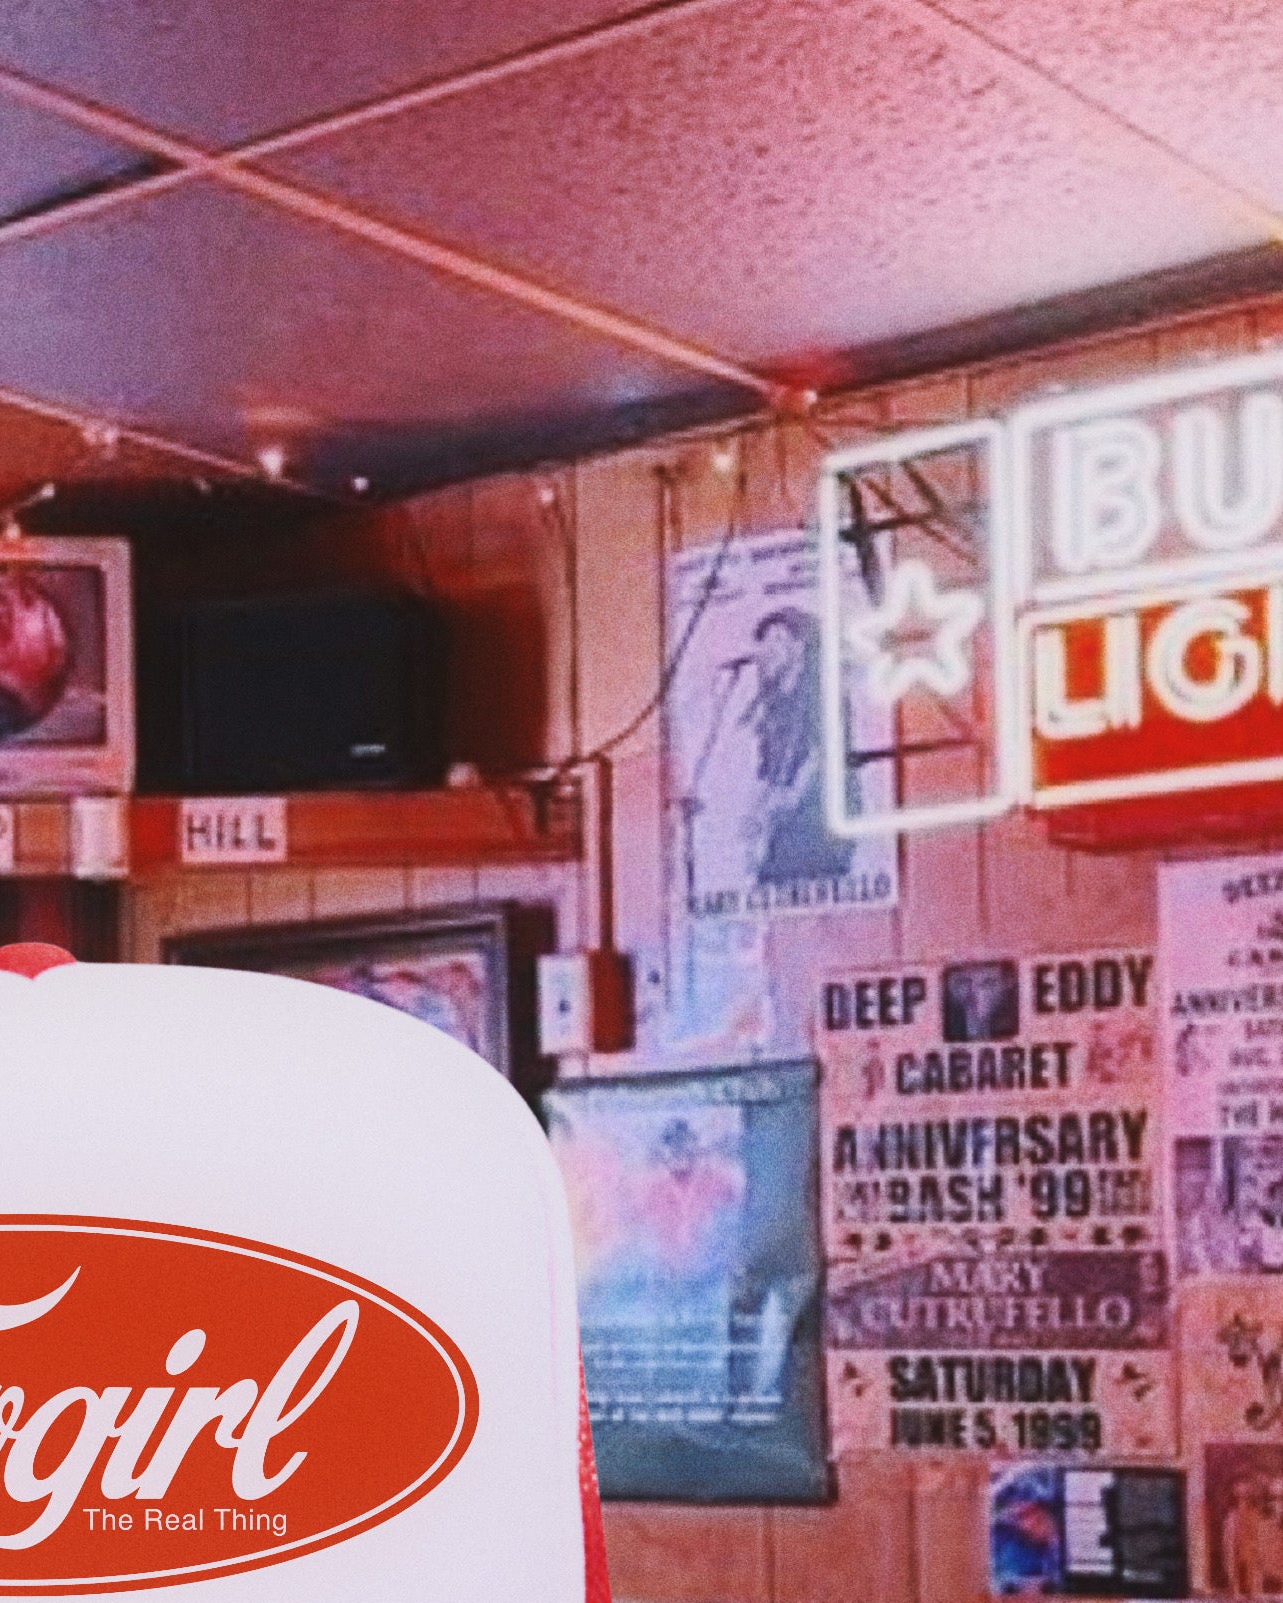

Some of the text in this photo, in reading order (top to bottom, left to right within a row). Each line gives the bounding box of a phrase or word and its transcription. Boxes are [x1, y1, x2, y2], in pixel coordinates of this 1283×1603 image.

[185, 813, 277, 853] HILL
[824, 956, 1154, 1031] DEEP EDDY
[895, 1042, 1076, 1097] CABARET
[888, 1171, 1005, 1225] BASH
[888, 1356, 1096, 1403] SATURDAY
[889, 1407, 967, 1448] JUNE
[1012, 1408, 1102, 1450] 1999
[82, 1508, 288, 1537] The Real Thing
